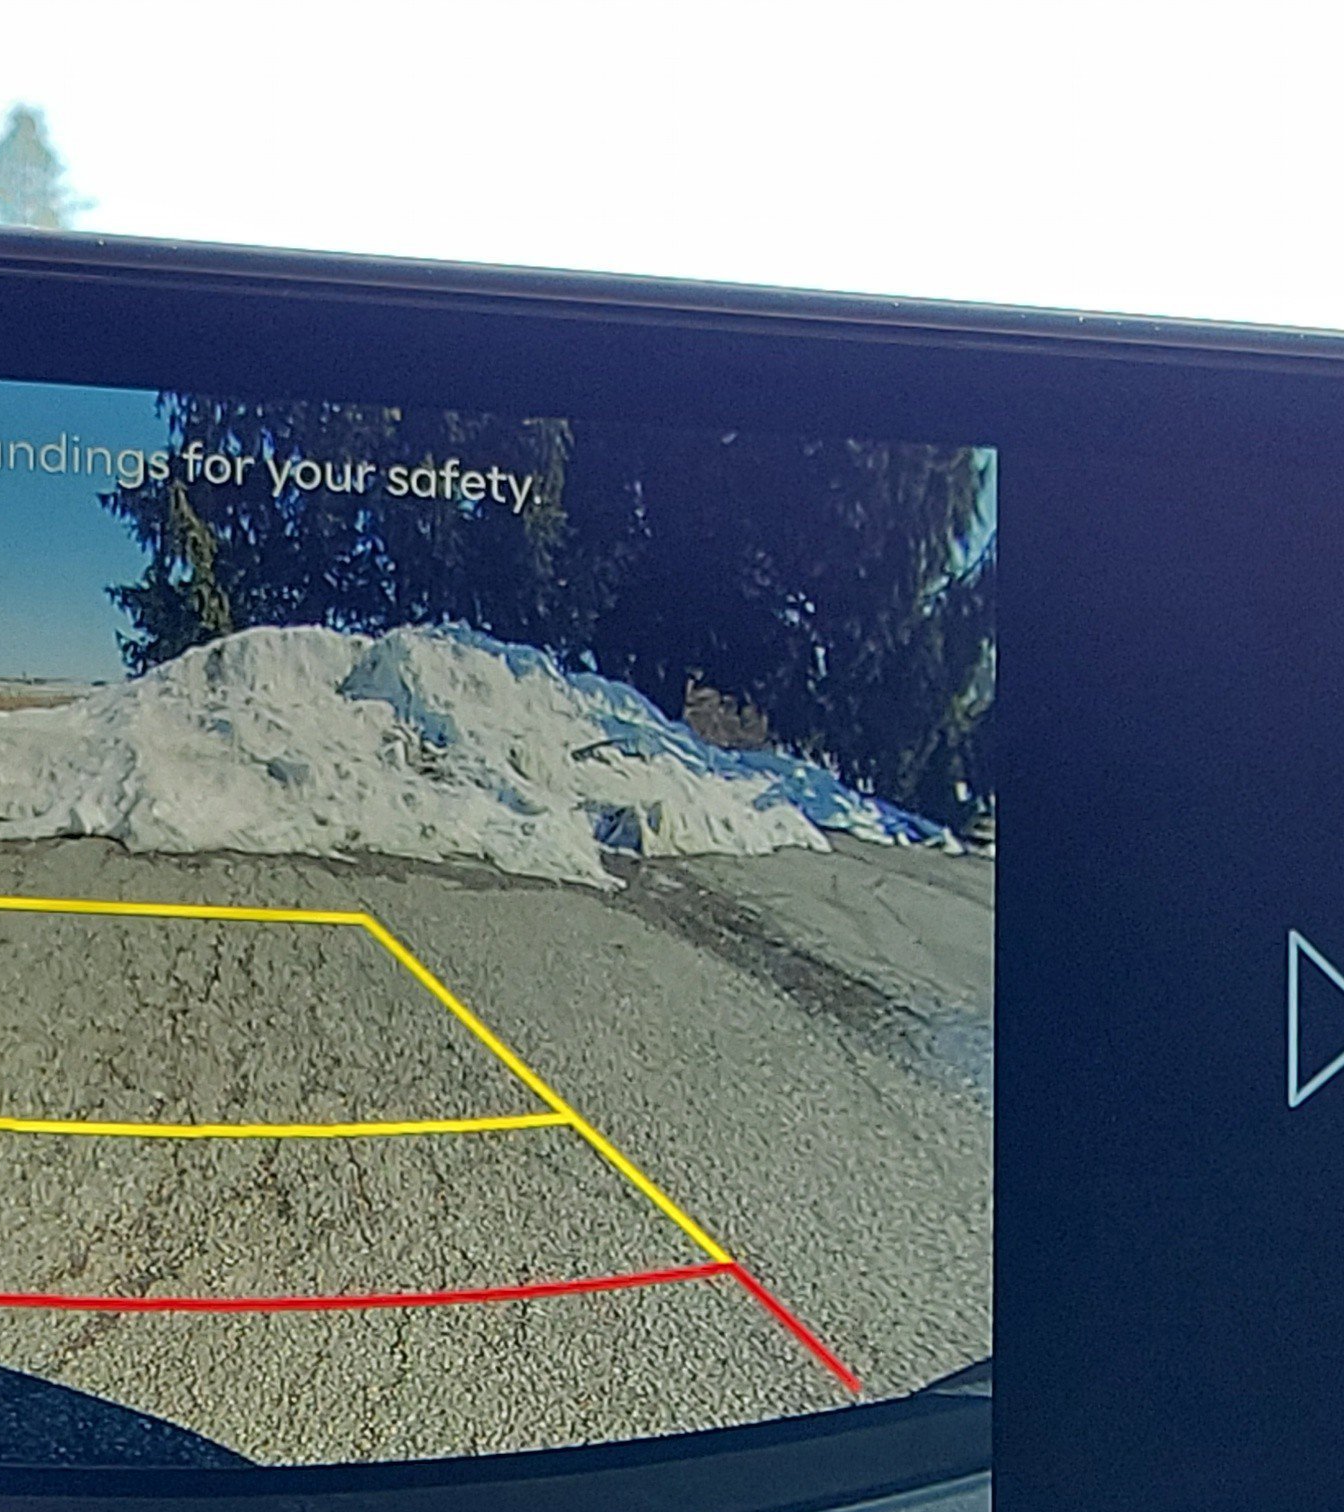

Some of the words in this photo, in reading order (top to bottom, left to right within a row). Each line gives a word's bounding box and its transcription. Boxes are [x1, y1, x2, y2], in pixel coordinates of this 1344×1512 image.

[182, 442, 254, 486] for
[267, 457, 374, 498] your
[386, 459, 544, 515] safety.
